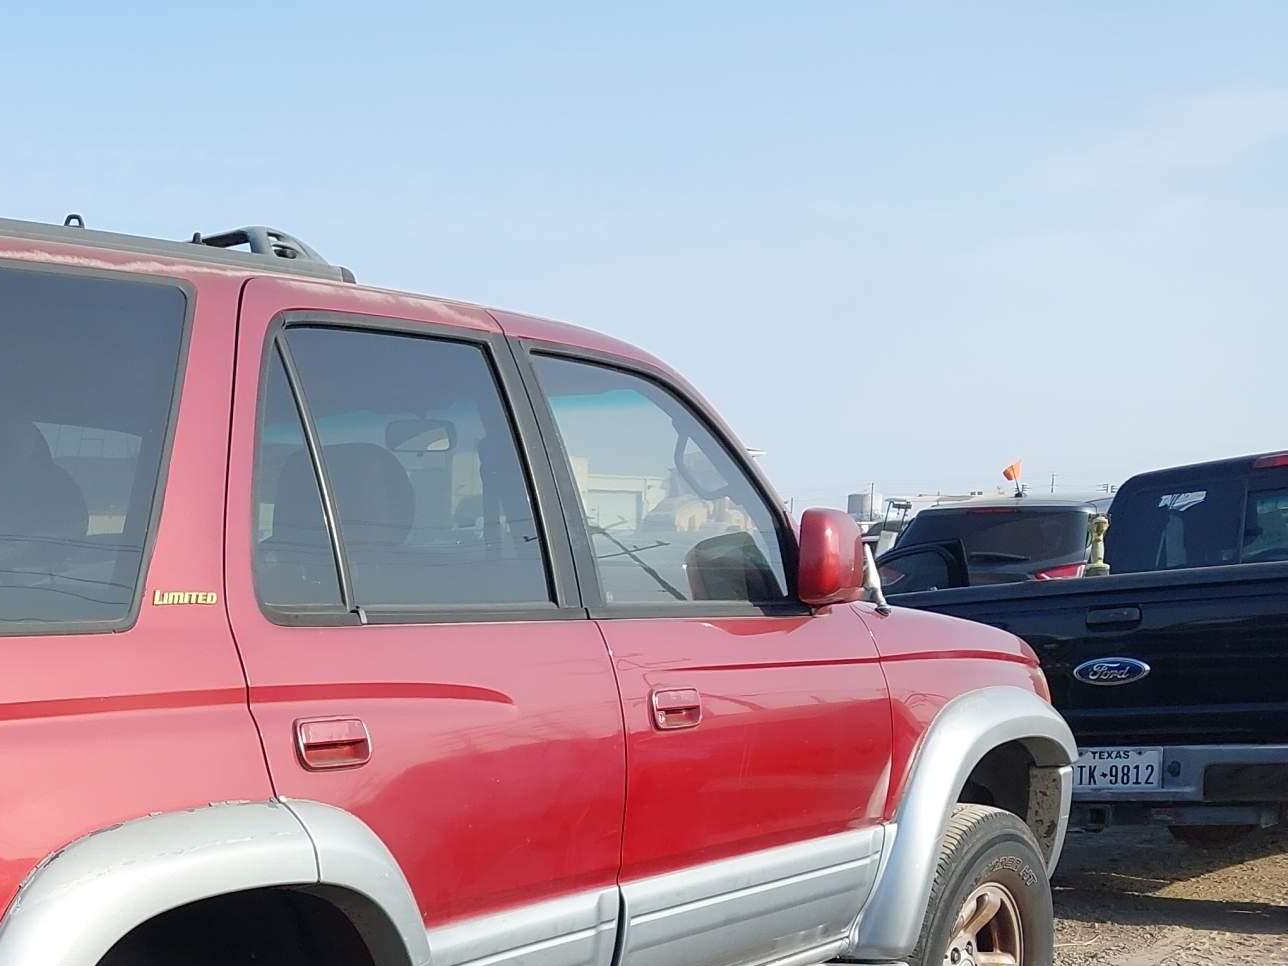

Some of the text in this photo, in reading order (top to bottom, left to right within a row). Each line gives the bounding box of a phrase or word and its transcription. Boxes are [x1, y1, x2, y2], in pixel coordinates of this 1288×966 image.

[153, 589, 218, 606] LIMITED
[1091, 750, 1131, 761] TEXAS
[1072, 763, 1155, 786] TK 9812
